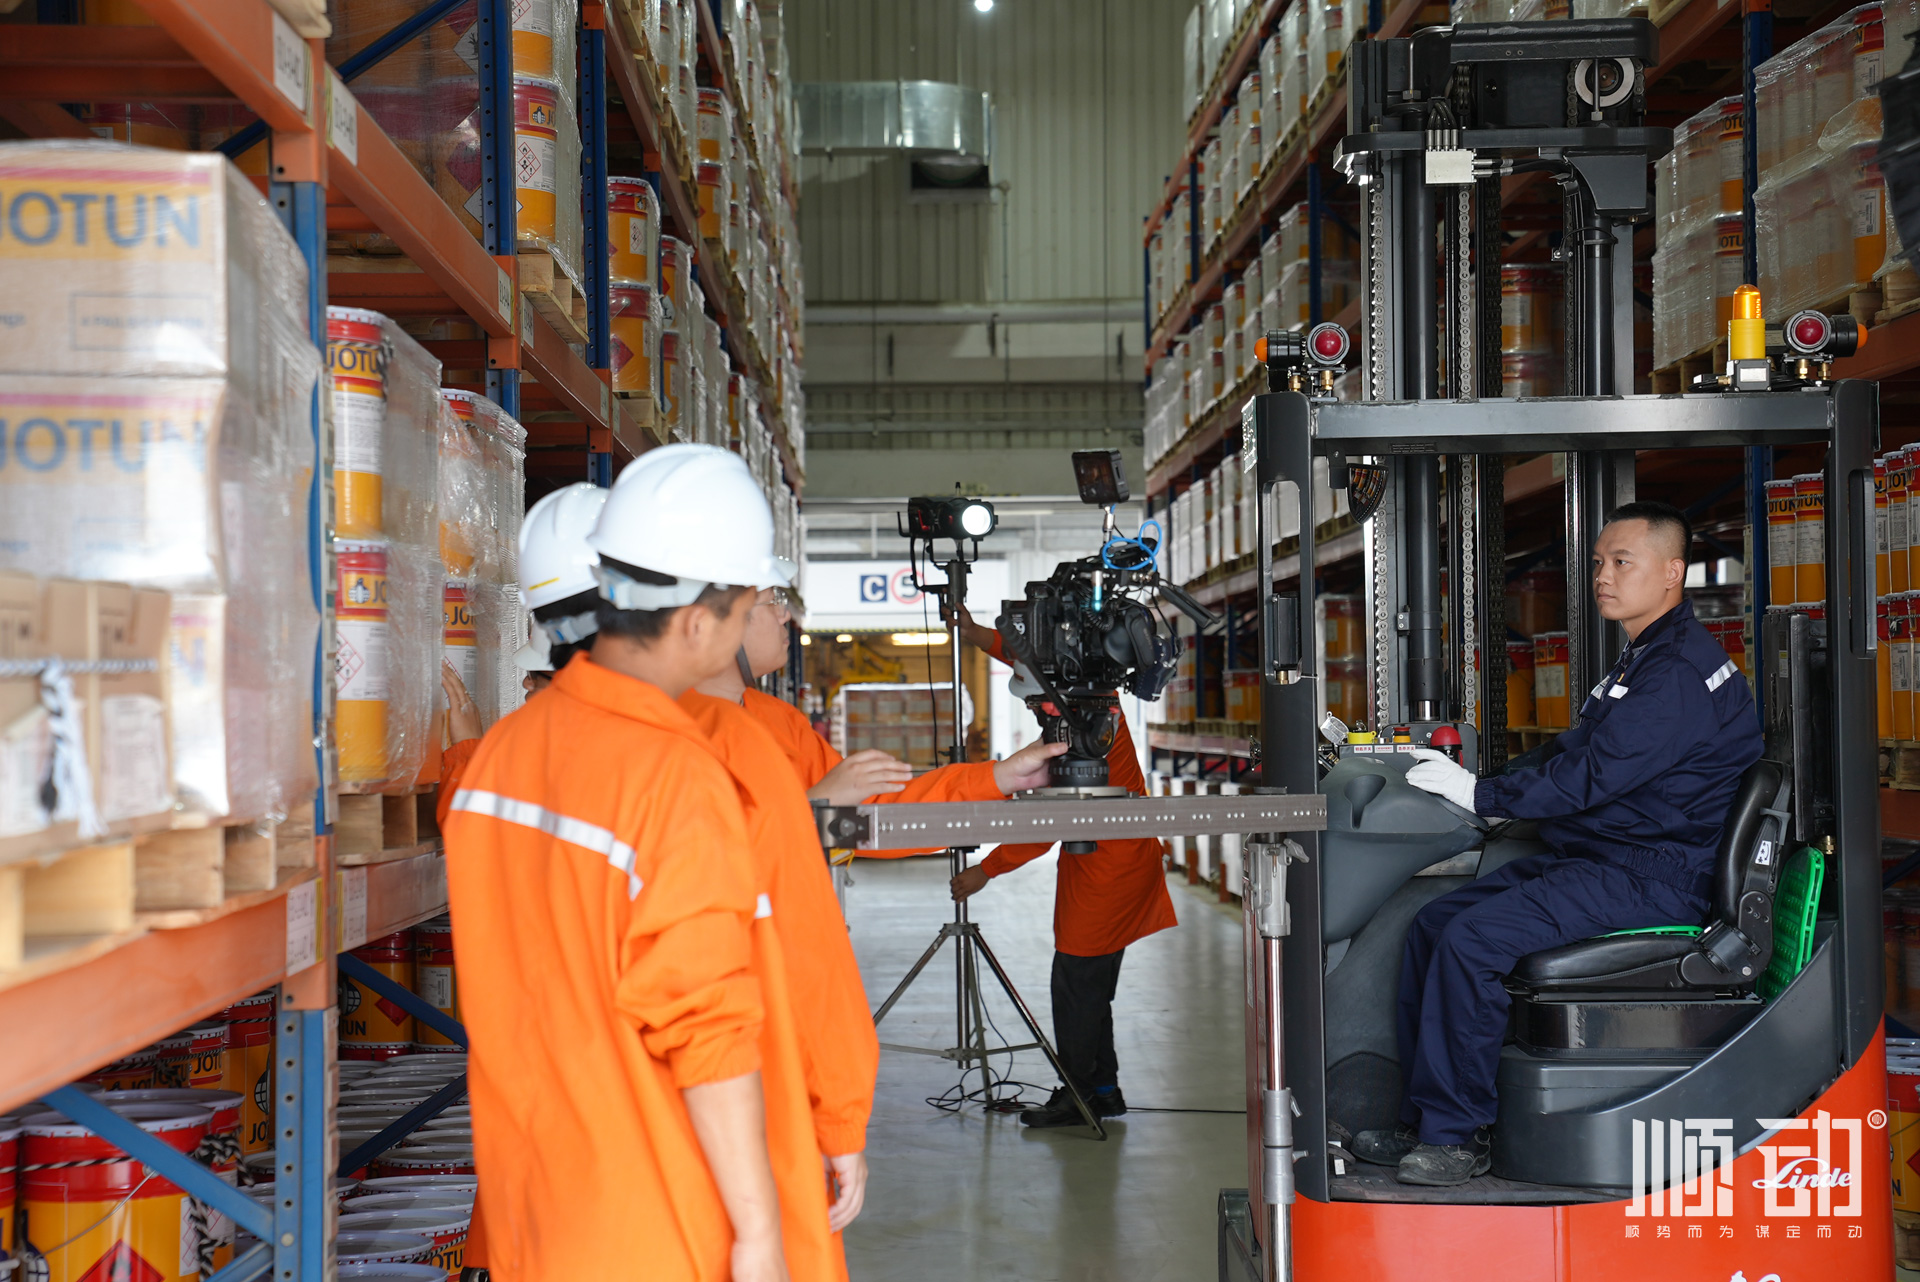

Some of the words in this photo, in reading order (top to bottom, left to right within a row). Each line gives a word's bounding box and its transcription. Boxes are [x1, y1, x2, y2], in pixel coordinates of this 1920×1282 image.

[0, 191, 200, 248] OTUN
[863, 576, 885, 599] C
[901, 576, 918, 598] 5
[1752, 1157, 1853, 1190] Linde
